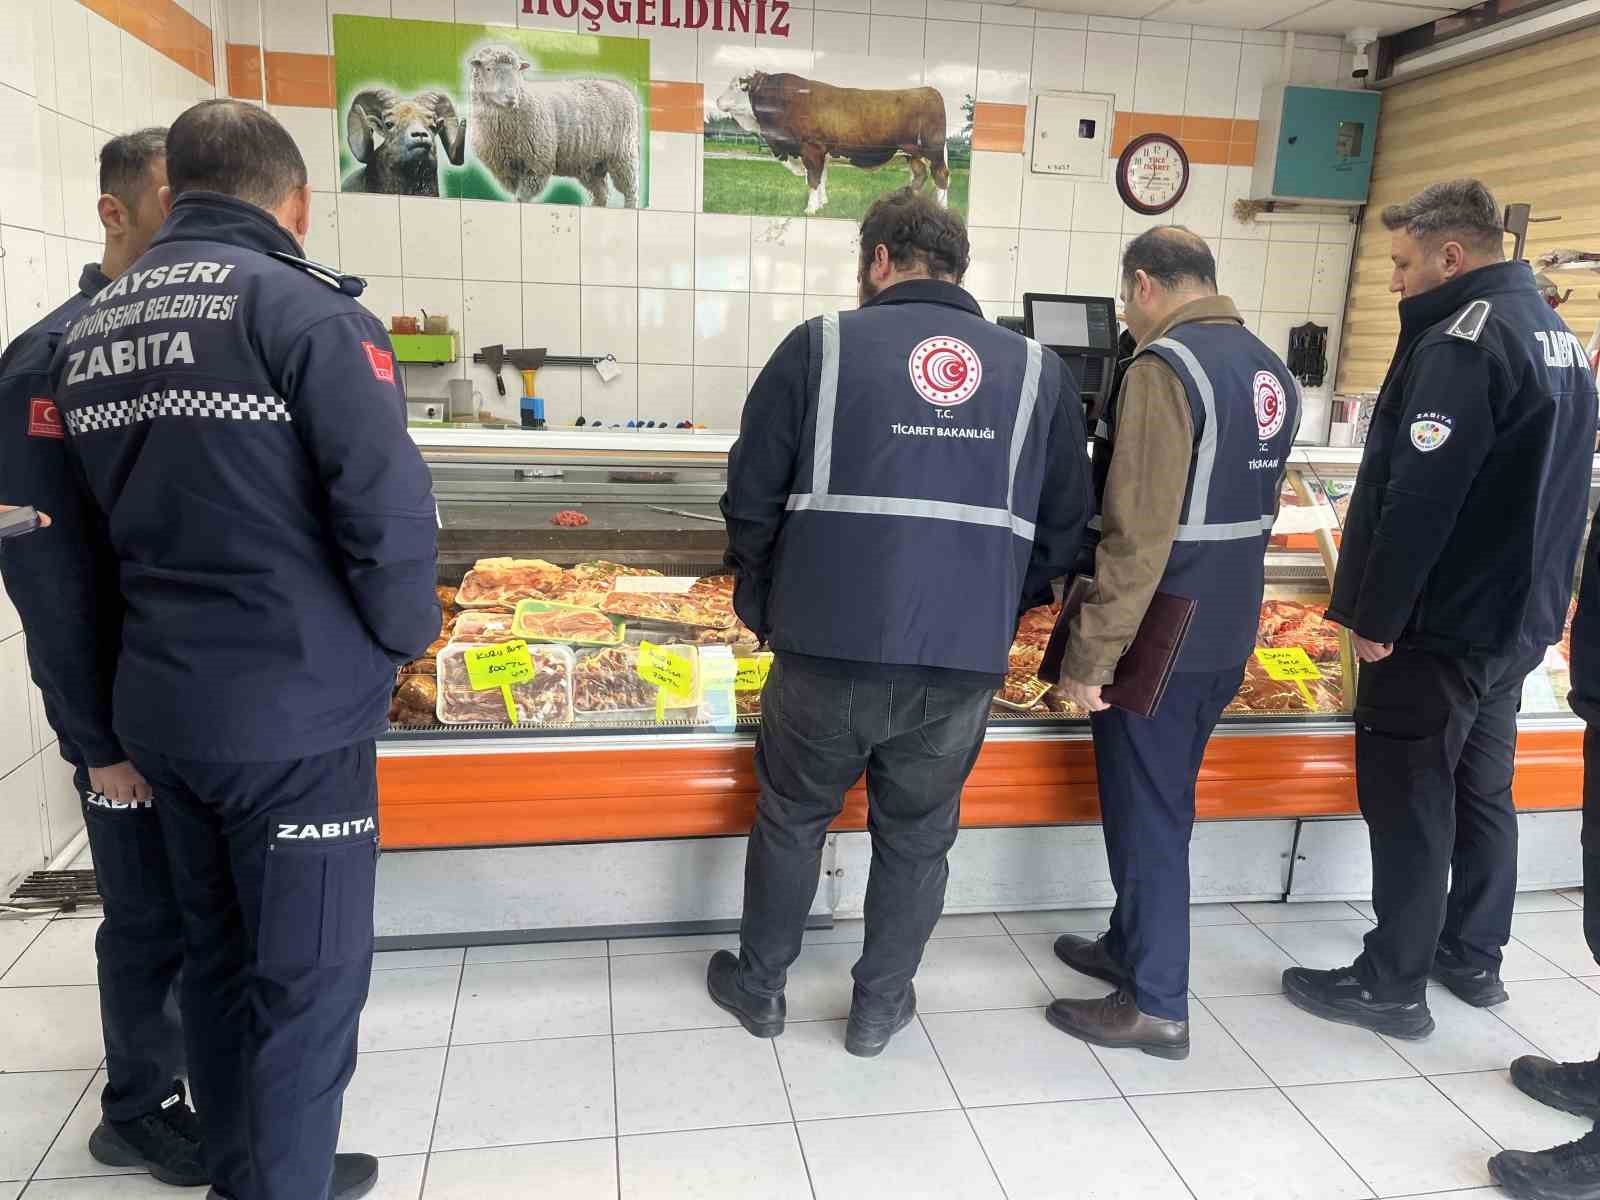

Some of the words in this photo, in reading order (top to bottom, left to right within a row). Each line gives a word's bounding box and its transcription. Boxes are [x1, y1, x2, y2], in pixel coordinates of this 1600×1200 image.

[66, 331, 196, 386] ZABITA
[935, 409, 954, 419] T.C.
[1416, 412, 1452, 424] ZABITA
[891, 422, 935, 436] TİCARET
[936, 427, 995, 439] BAKANLIĞI
[276, 816, 375, 839] ZABITA
